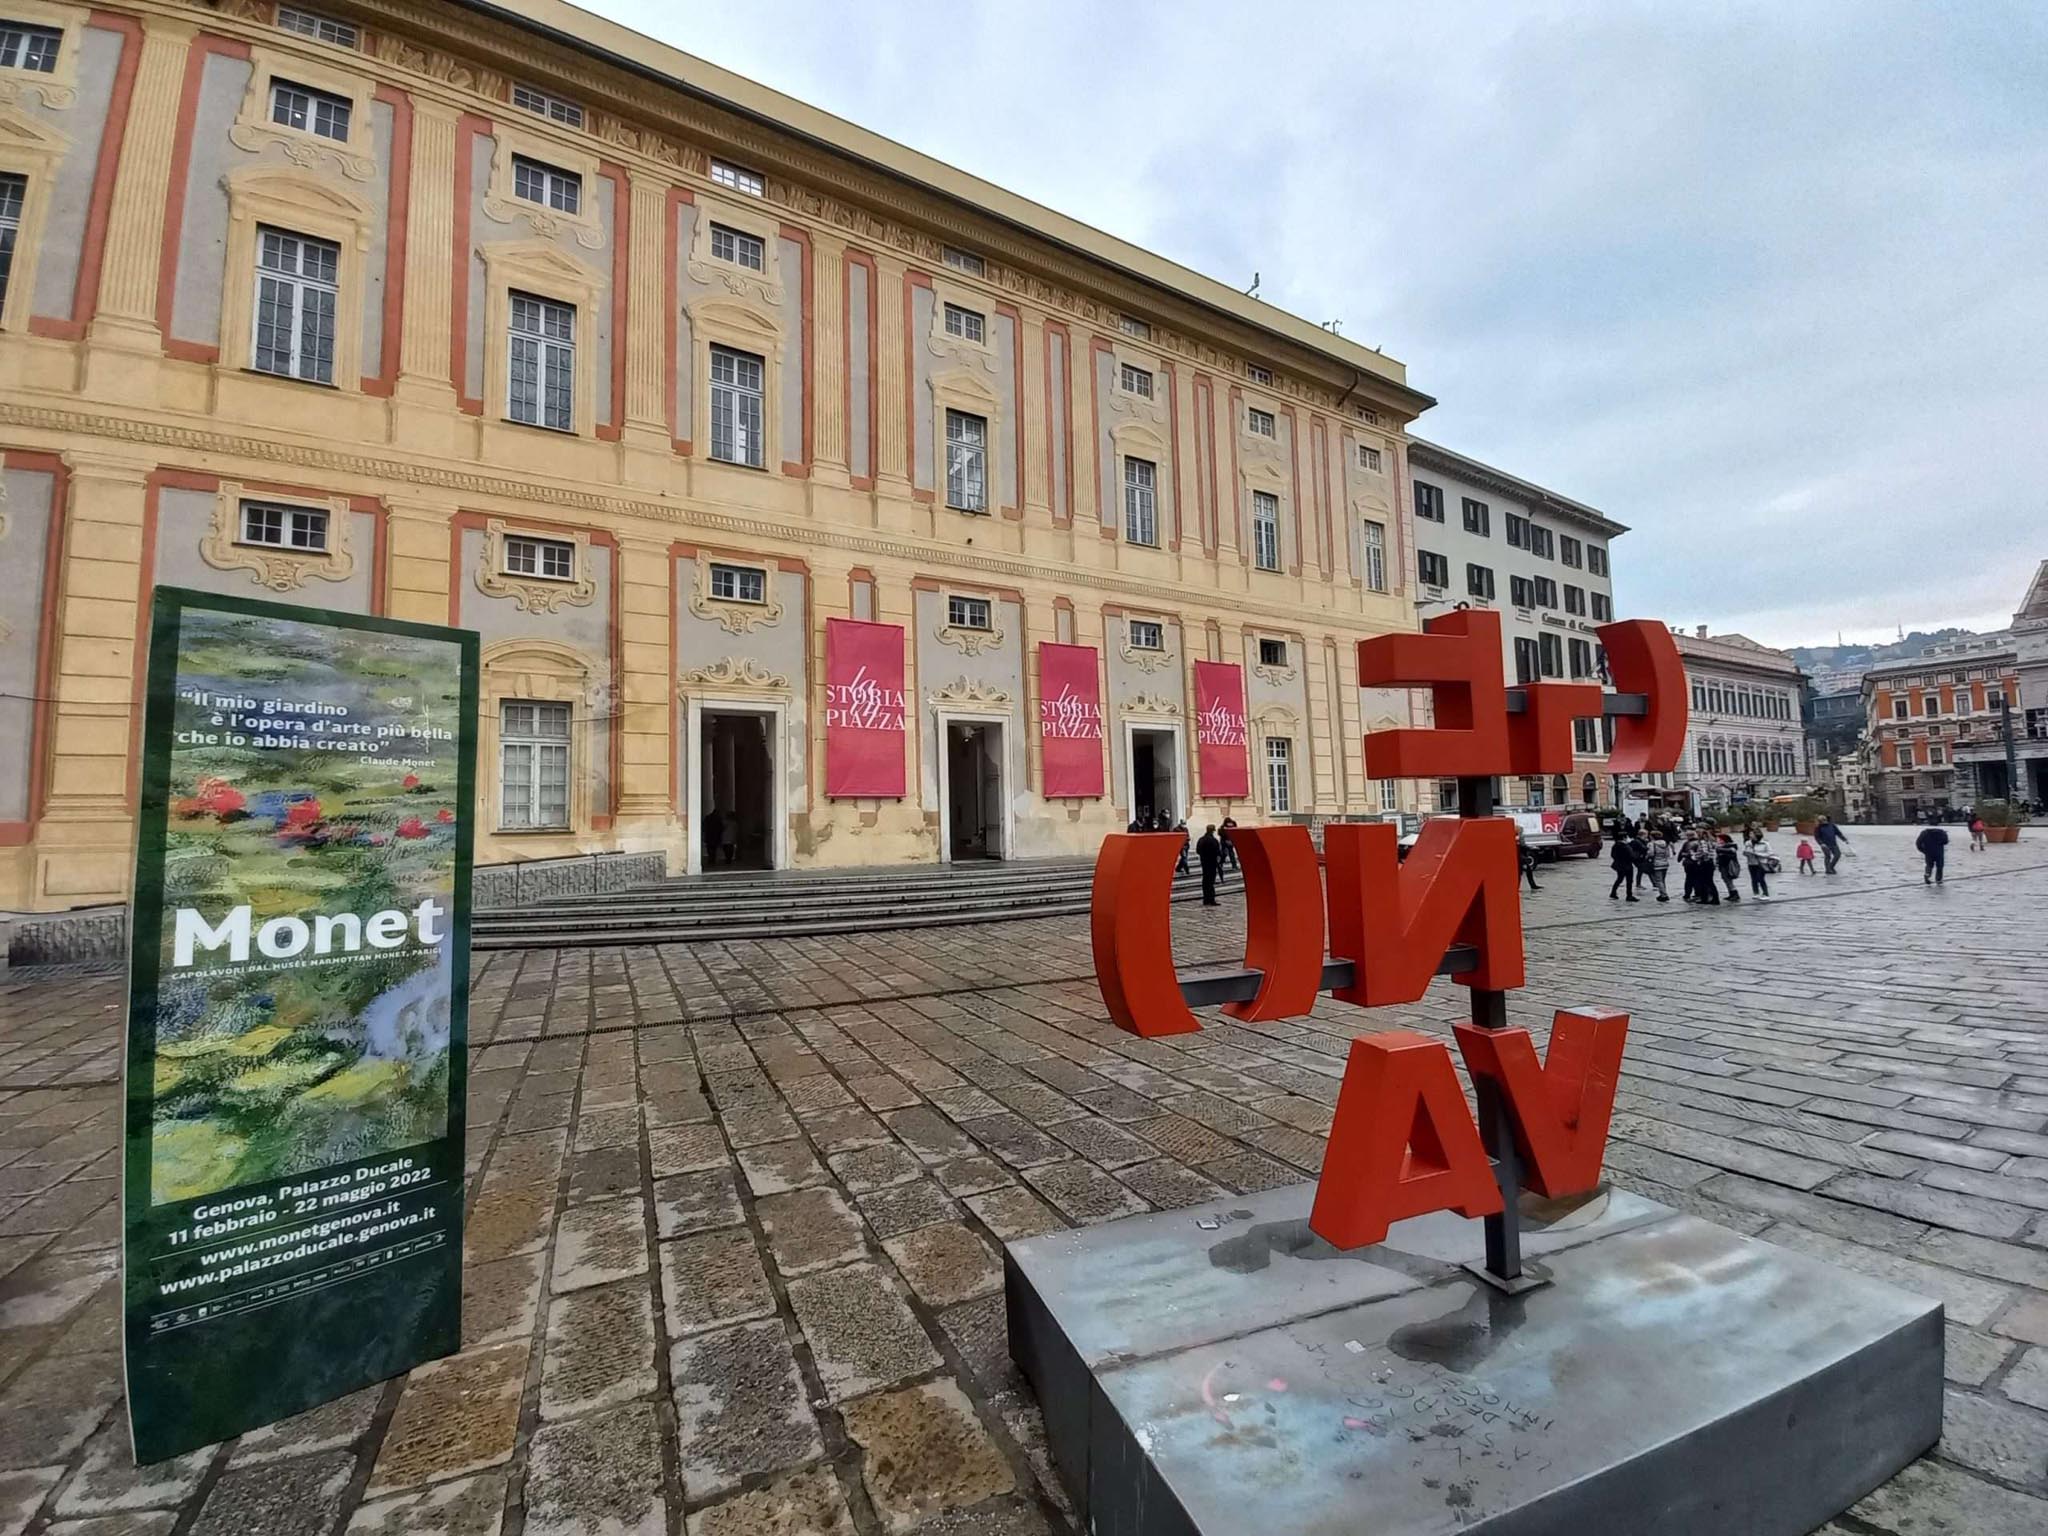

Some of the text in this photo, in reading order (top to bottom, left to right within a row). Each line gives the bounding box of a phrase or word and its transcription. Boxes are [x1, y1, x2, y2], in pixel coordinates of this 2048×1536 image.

[215, 696, 257, 710] mio
[262, 698, 348, 717] giardino
[826, 684, 905, 707] STORIA
[826, 708, 905, 731] PIAZZA
[1041, 700, 1102, 718] STORIA
[1198, 712, 1245, 727] STORIA
[211, 711, 224, 726] è
[377, 723, 406, 741] più
[411, 726, 453, 741] bella
[1042, 721, 1103, 738] PIAZZA
[1199, 730, 1246, 745] PIAZZA
[178, 731, 220, 745] che
[225, 731, 246, 746] io
[253, 733, 311, 749] abbia
[360, 756, 436, 768] Claude Monet
[173, 898, 445, 968] Monet
[172, 965, 245, 980] CAPOLAVORI
[248, 964, 271, 973] DAL
[310, 955, 372, 967] MARMOTTAN
[192, 1157, 413, 1221] Genova, Palazzo Ducale
[168, 1228, 188, 1247] 11
[193, 1209, 277, 1239] febbraio
[295, 1198, 318, 1215] 22
[322, 1181, 386, 1208] maggio
[390, 1167, 431, 1188] 2022
[200, 1200, 401, 1267] www.monetgenova.it
[160, 1206, 436, 1296] www.palazzoducale.genova.it
